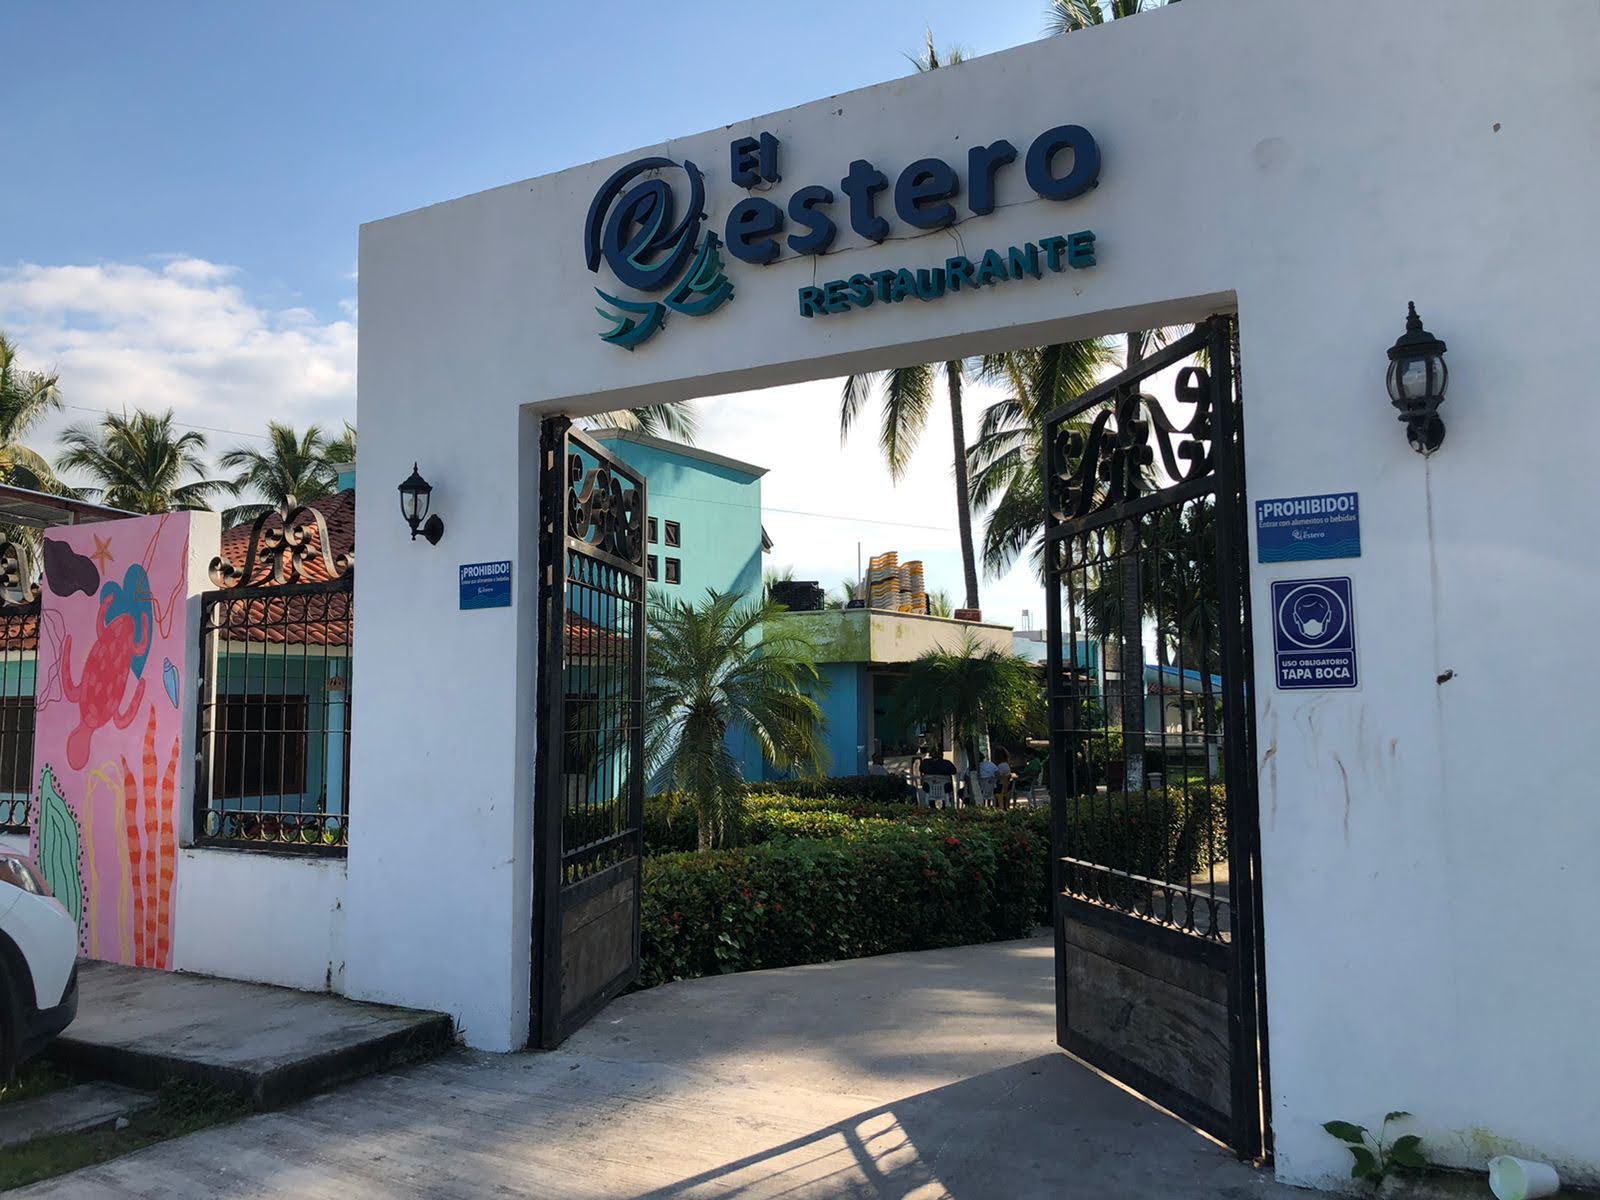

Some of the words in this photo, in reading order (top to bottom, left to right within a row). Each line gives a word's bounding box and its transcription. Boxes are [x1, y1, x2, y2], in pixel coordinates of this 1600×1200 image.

[730, 131, 782, 188] El
[725, 124, 1101, 265] estero
[798, 229, 1096, 318] RESTAURANTE
[1259, 495, 1354, 520] ¡PROHIBIDO!
[1291, 517, 1324, 526] alimentos
[1329, 513, 1357, 523] bebidas
[461, 563, 509, 580] ¡PROHIBIDO!
[1282, 668, 1312, 679] TAPA
[1315, 667, 1350, 679] BOCA
[1299, 658, 1349, 667] OBLIGATORIO
